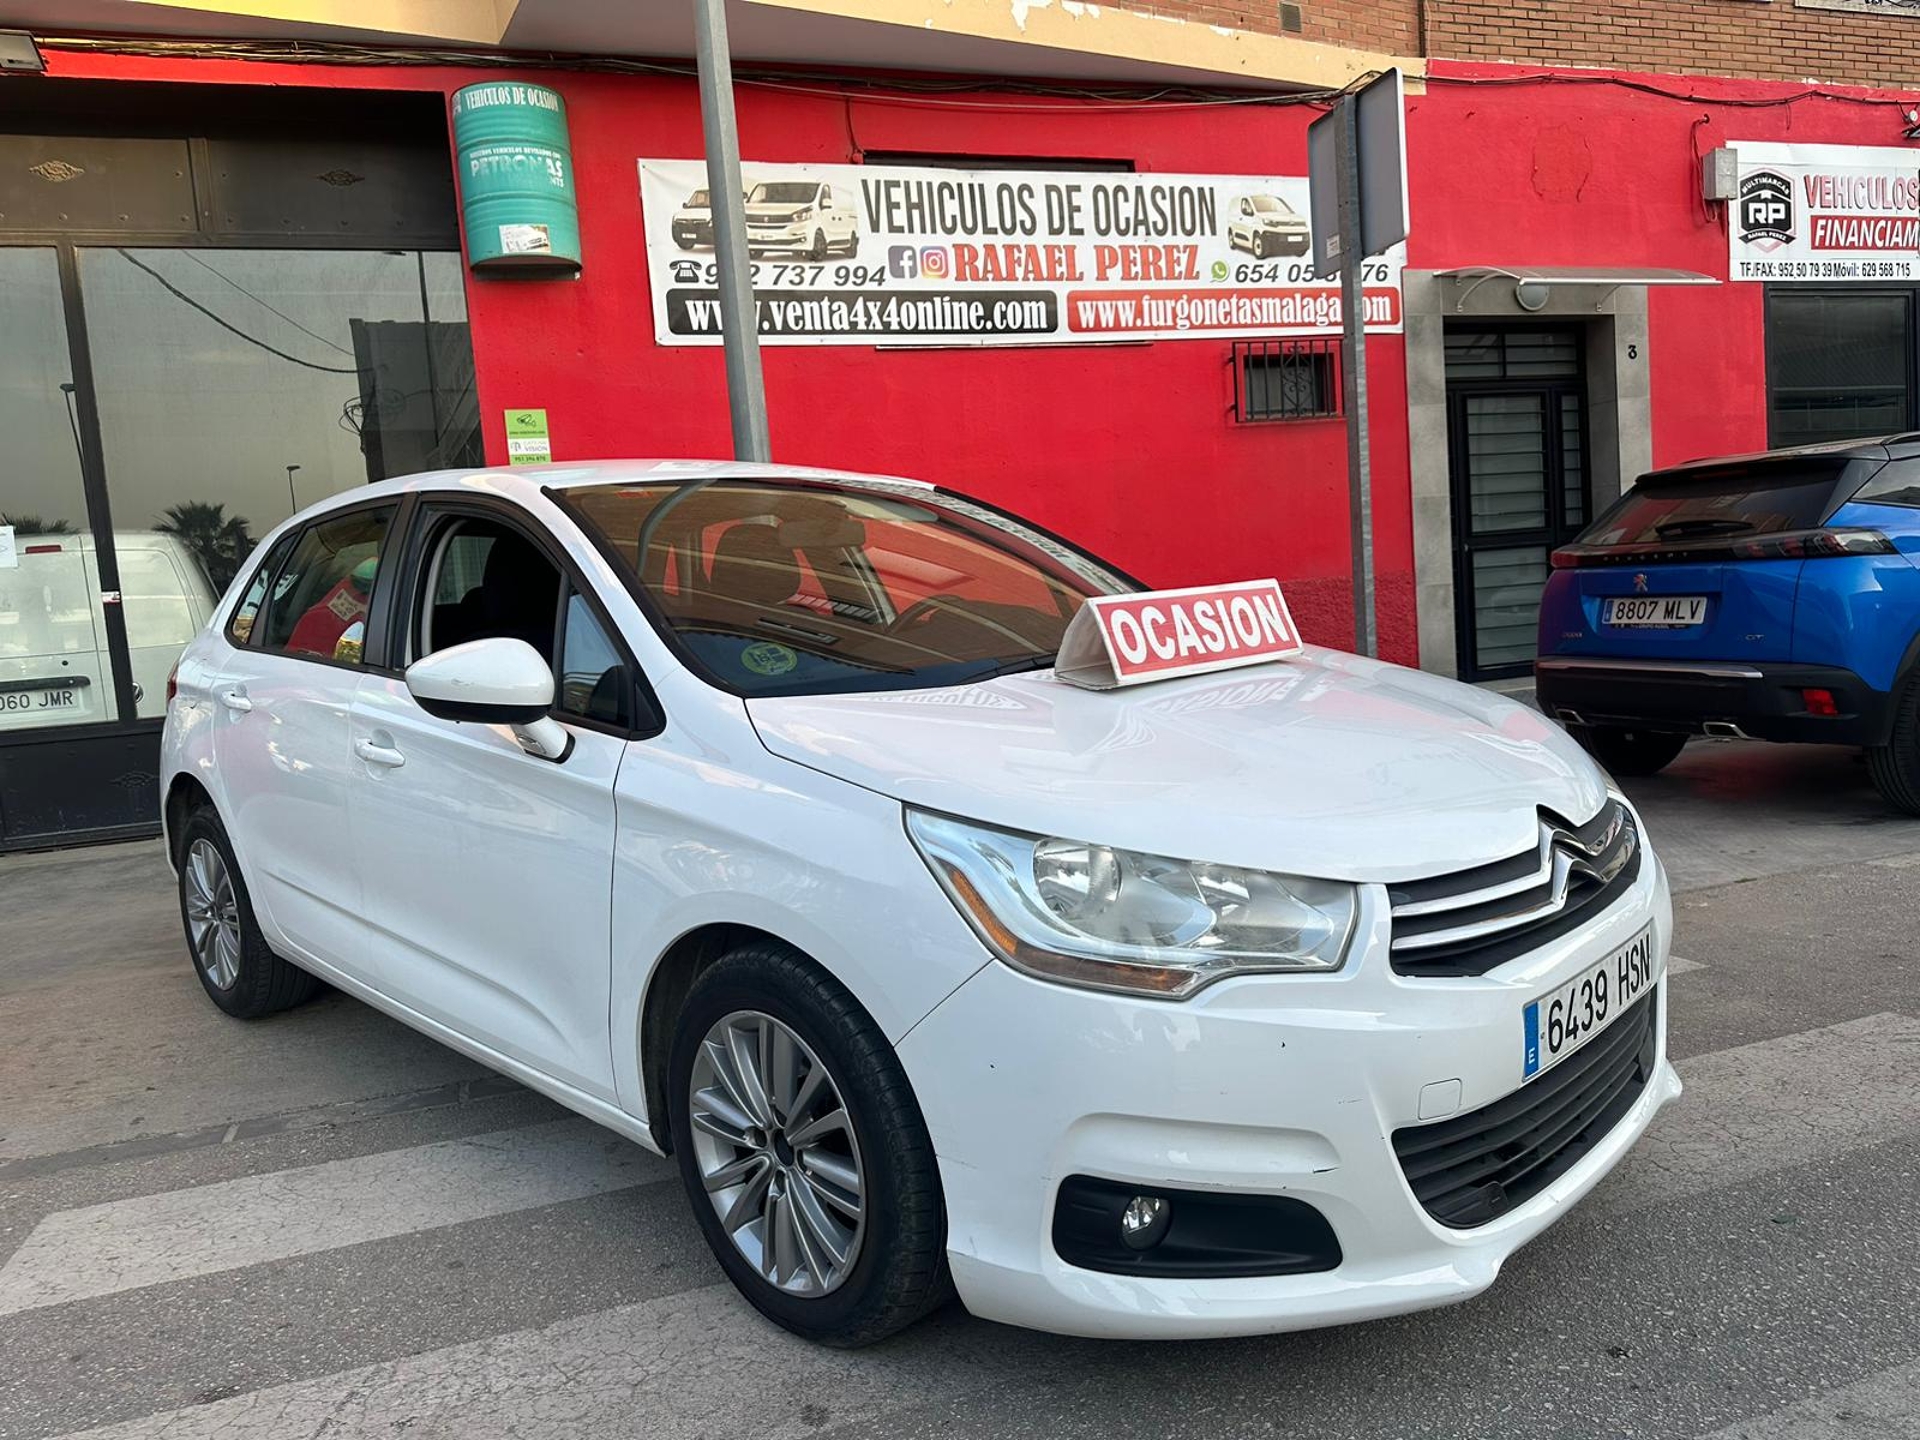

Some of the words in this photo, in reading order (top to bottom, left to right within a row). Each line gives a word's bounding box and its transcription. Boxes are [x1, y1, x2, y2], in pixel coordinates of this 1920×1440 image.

[465, 86, 511, 110] VEHICULOS
[512, 86, 526, 105] DE
[1741, 177, 1790, 195] MULTIMARCAS
[1803, 174, 1918, 210] VEHICULOS
[861, 178, 1037, 236] VEHICULOS
[1044, 184, 1085, 236] DE
[1092, 184, 1217, 237] OCASION
[1748, 202, 1786, 224] RP
[952, 243, 1084, 282] RAFAEL
[1093, 244, 1200, 282] PEREZ
[1235, 264, 1279, 283] 654
[1778, 262, 1794, 277] 952
[1795, 262, 1807, 277] 50
[1809, 262, 1820, 277] 79
[1821, 262, 1832, 277] 39
[1861, 262, 1877, 277] 629
[1878, 262, 1894, 277] 568
[1895, 262, 1911, 277] 715
[704, 263, 760, 285] 92
[772, 264, 825, 286] 737
[833, 265, 886, 287] 994
[684, 296, 1047, 331] w.venta4x4online.com
[1077, 292, 1392, 330] www.furgonetasmalagaom
[1628, 344, 1638, 360] 3
[1615, 601, 1658, 620] 8807
[1663, 600, 1701, 620] MLV
[1110, 594, 1290, 664] OCASION
[39, 690, 73, 707] JMR
[1548, 969, 1608, 1054] 6439
[1618, 933, 1651, 1006] HSN
[1528, 1047, 1536, 1064] E
